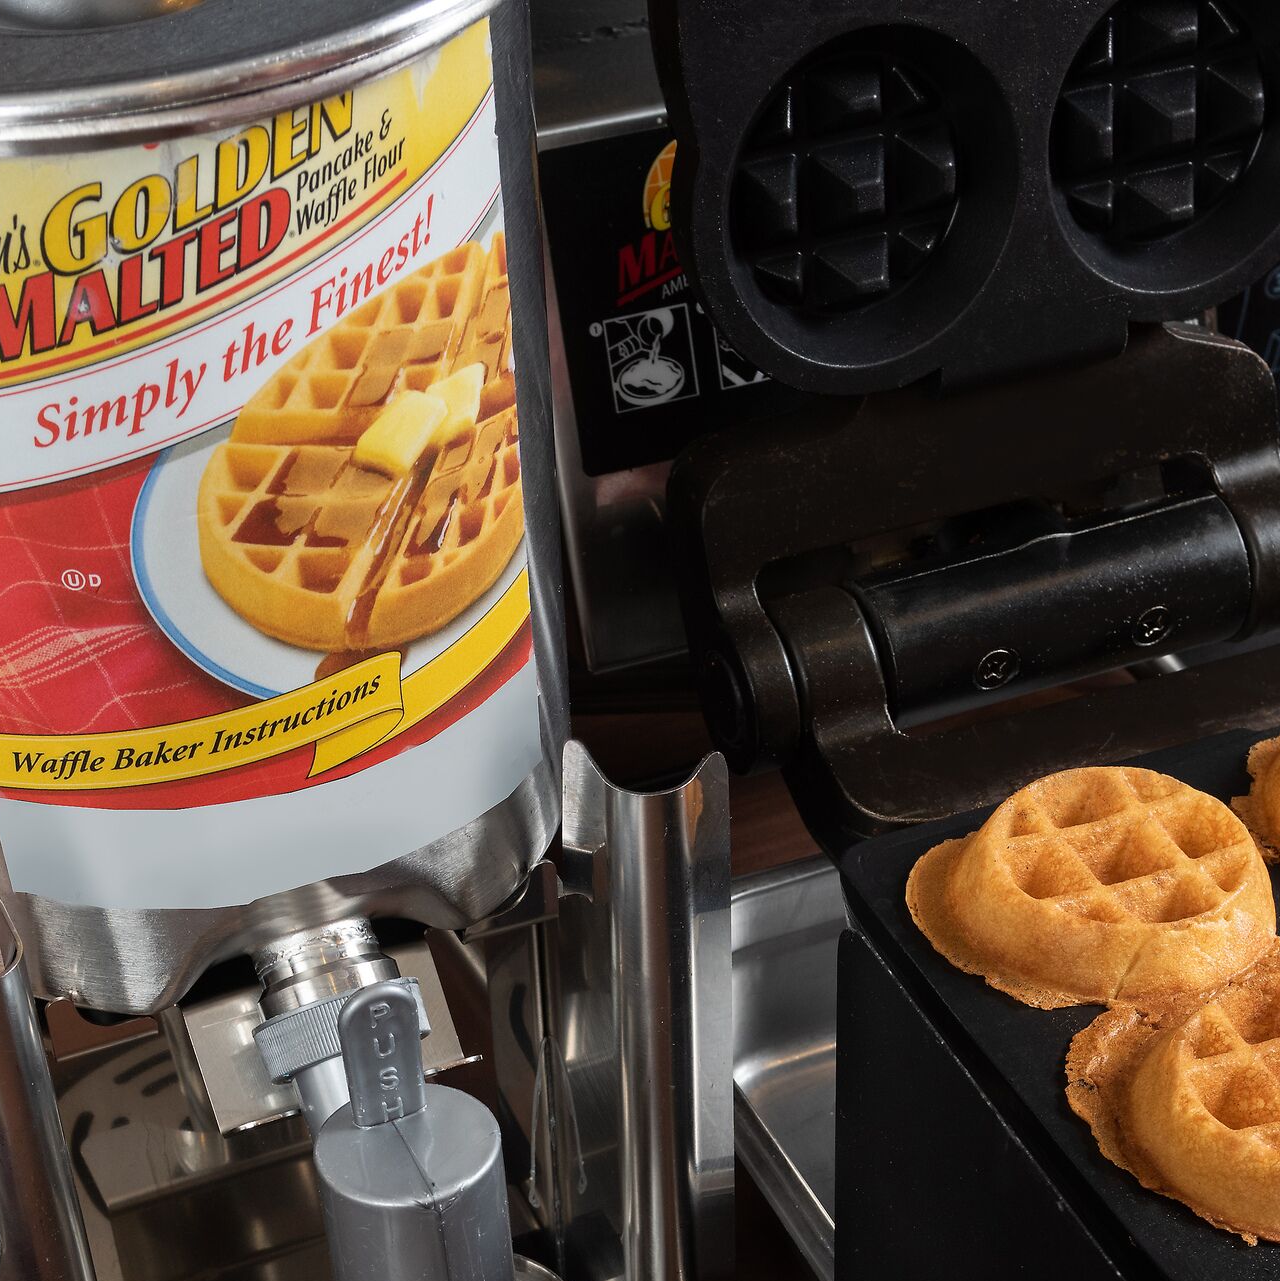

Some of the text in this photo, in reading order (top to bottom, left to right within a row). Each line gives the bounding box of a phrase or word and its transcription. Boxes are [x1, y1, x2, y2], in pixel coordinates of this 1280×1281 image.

[40, 91, 357, 276] GOLDEN
[295, 137, 407, 237] Waffle Flour
[297, 109, 393, 202] Pancake &
[32, 194, 437, 449] Simply the Finest!
[88, 573, 102, 587] D
[11, 673, 382, 781] Waffle Baker Instructions
[369, 1002, 405, 1124] PUSH
